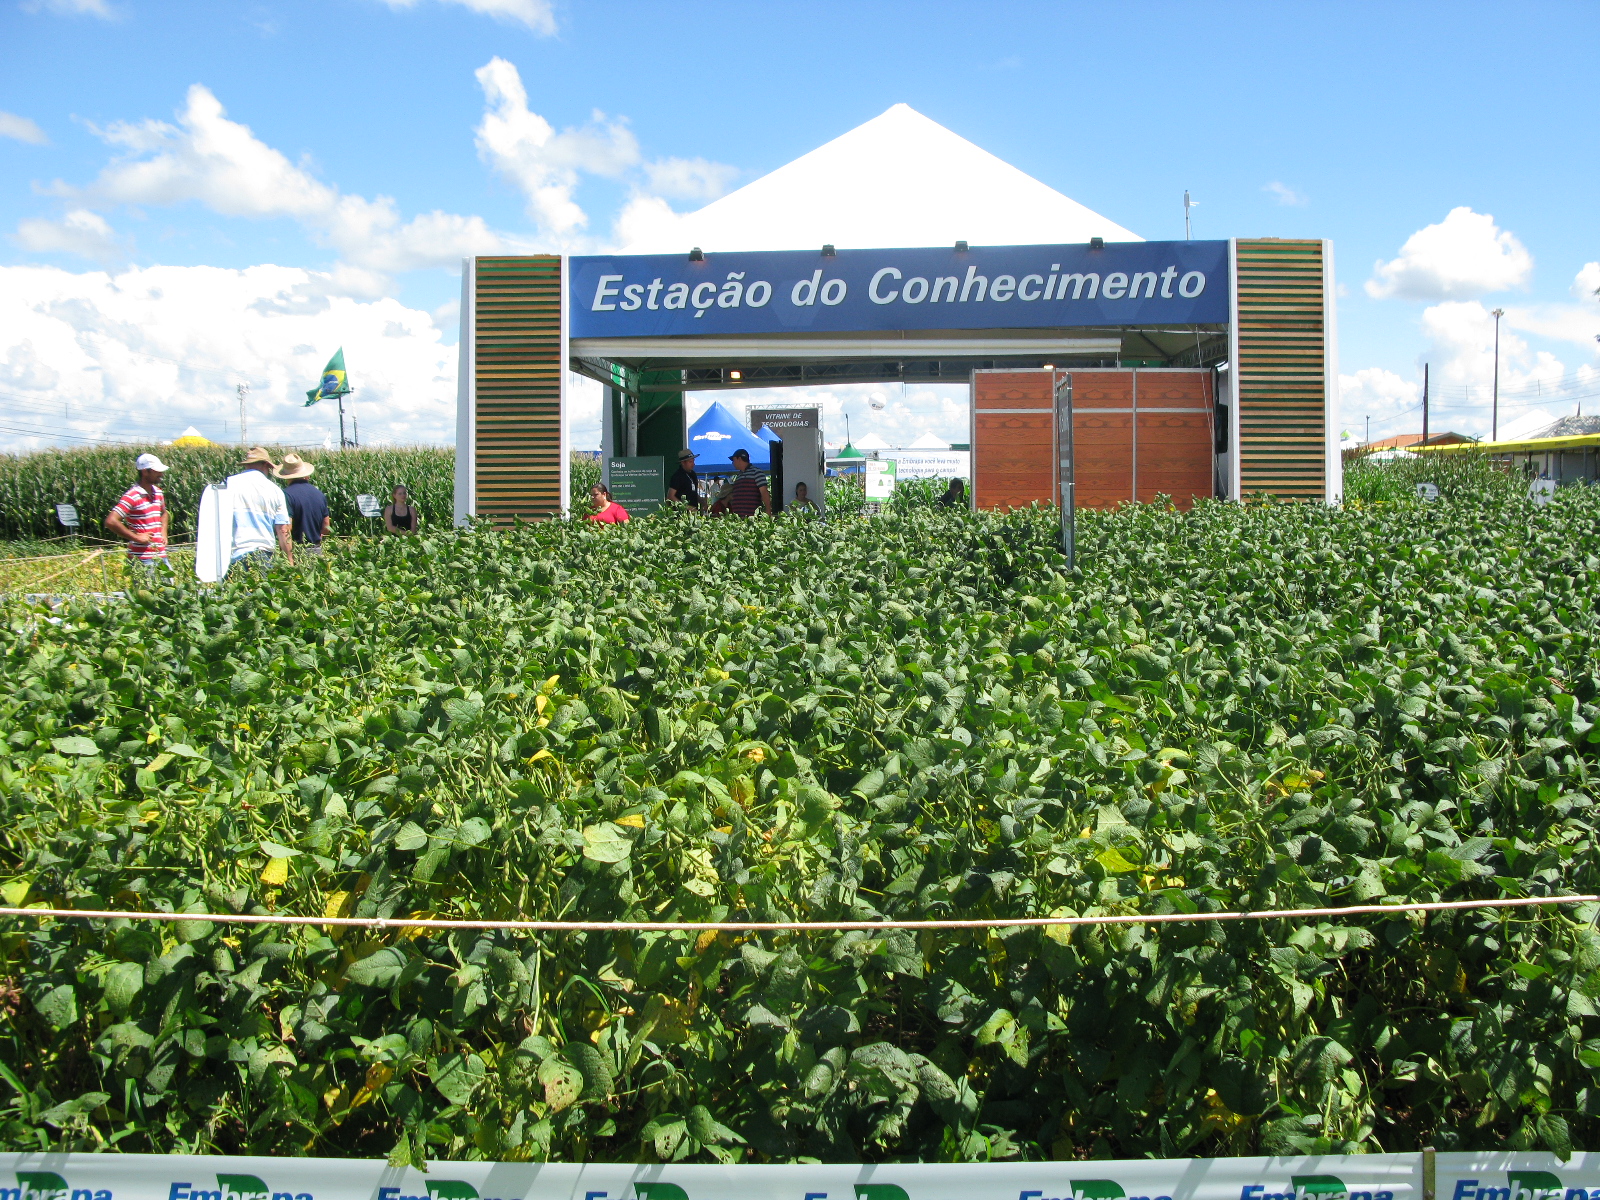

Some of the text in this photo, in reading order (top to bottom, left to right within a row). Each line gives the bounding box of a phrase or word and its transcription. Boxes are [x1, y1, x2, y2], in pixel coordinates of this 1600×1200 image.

[591, 263, 1206, 318] Estação do Conhecimento
[761, 420, 809, 428] TECNOLOGIAS
[611, 461, 626, 469] Soja
